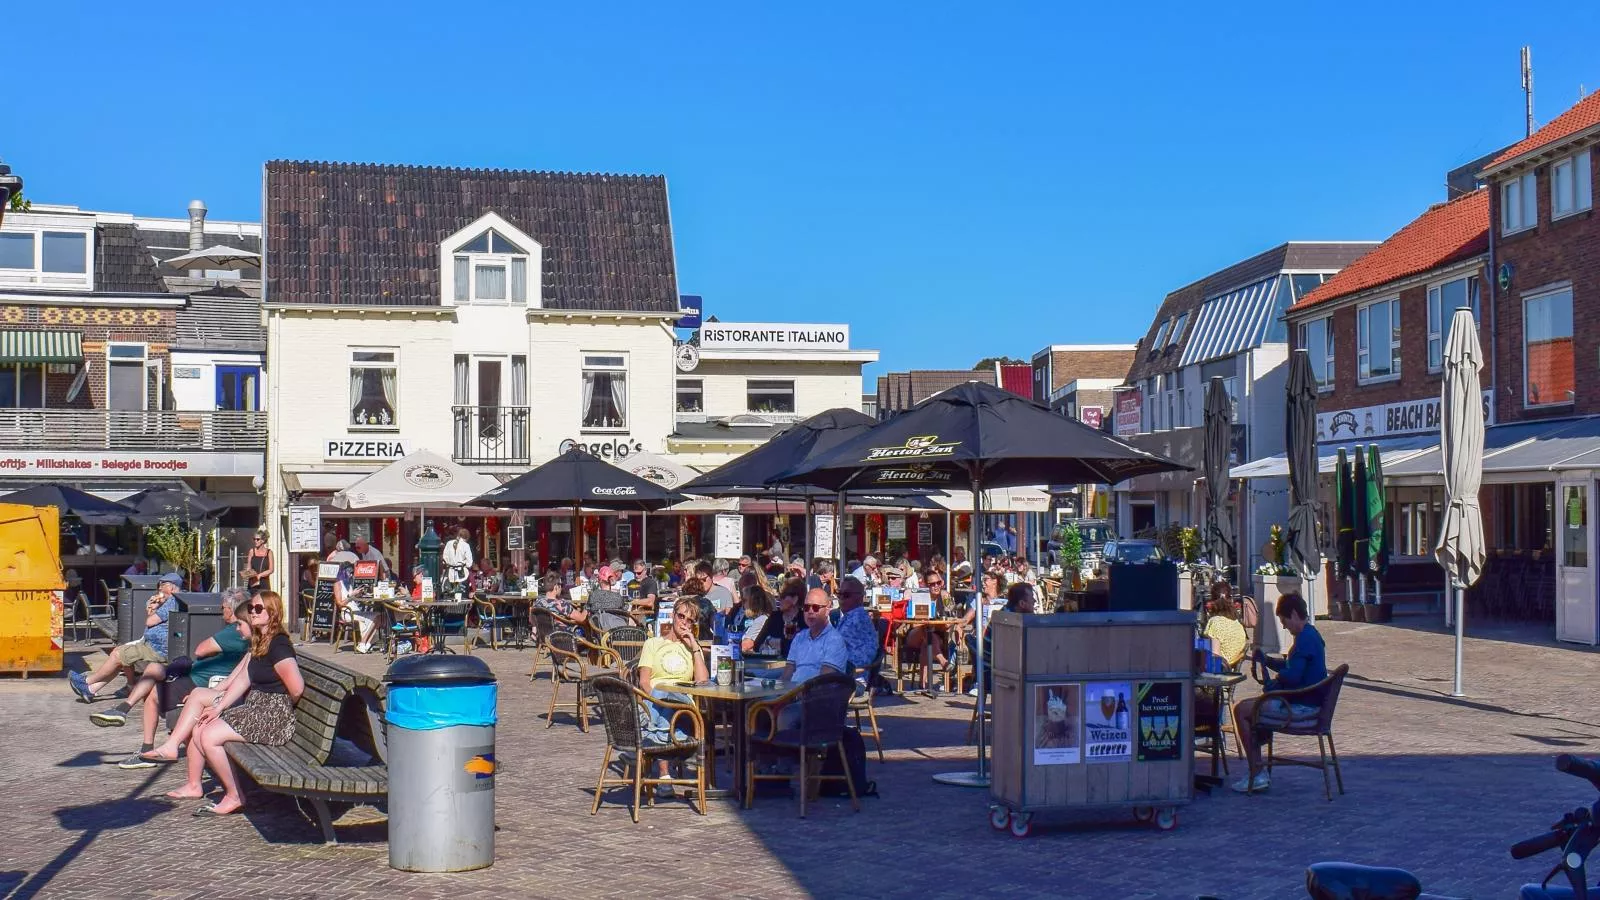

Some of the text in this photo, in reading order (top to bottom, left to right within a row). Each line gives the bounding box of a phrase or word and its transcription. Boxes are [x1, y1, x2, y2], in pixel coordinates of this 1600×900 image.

[1386, 405, 1423, 431] BEACH
[0, 459, 26, 471] oftijs
[36, 459, 92, 469] Milkshakes
[101, 460, 142, 471] Belegde
[144, 460, 188, 471] Broodjes
[591, 486, 638, 496] Coca-Cola
[1151, 695, 1169, 704] Proef
[1153, 704, 1177, 713] voorjaar
[1090, 729, 1127, 741] Weizen
